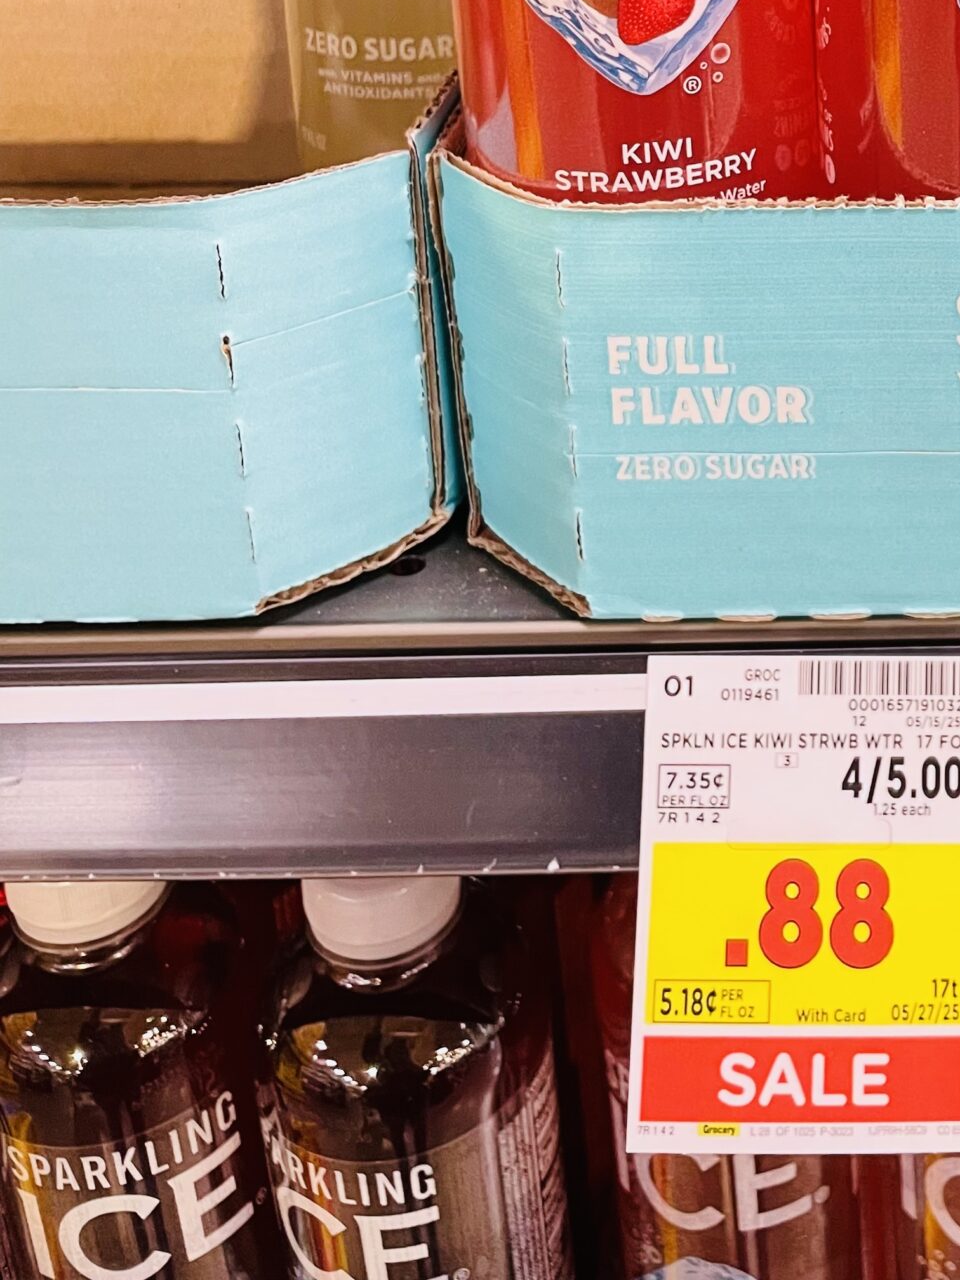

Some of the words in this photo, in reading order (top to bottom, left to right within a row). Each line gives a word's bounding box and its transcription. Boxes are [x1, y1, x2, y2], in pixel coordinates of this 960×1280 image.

[304, 27, 358, 60] ZERO
[364, 35, 453, 62] SUGAR
[340, 70, 412, 84] VITAMINS
[621, 137, 693, 164] KIWI
[555, 148, 757, 193] STRAWBERRY
[721, 180, 766, 201] Water
[607, 335, 730, 375] FULL
[610, 385, 812, 425] FLAVOR
[616, 456, 696, 480] ZERO
[705, 455, 814, 480] SUGAR
[744, 668, 781, 682] GROC
[721, 688, 780, 701] 0119461
[853, 716, 867, 727] 12
[906, 716, 960, 729] 05/15/25
[661, 733, 715, 749] SPKLN
[721, 733, 747, 748] ICE
[754, 733, 793, 748] KIWI
[798, 733, 859, 748] STRWB
[865, 733, 903, 748] WTR
[917, 734, 933, 748] 17
[784, 755, 791, 766] 3
[666, 772, 724, 790] 7.35¢
[662, 795, 684, 806] PER
[690, 795, 704, 806] FL
[709, 795, 727, 806] OZ
[873, 804, 897, 816] 1.25
[901, 804, 931, 816] each
[725, 858, 894, 969] .88
[932, 979, 958, 998] 17t
[660, 987, 718, 1016] 5.18¢
[721, 989, 743, 1001] PER
[721, 1007, 735, 1018] FL
[739, 1006, 755, 1018] OZ
[796, 1008, 829, 1023] With
[834, 1008, 866, 1023] Card
[891, 1004, 960, 1022] 05/27/25
[717, 1052, 891, 1107] SALE
[703, 1124, 736, 1136] Grocery
[7, 1090, 237, 1192] SPARKLING
[17, 1131, 254, 1280] ICE
[276, 1187, 458, 1280] CE
